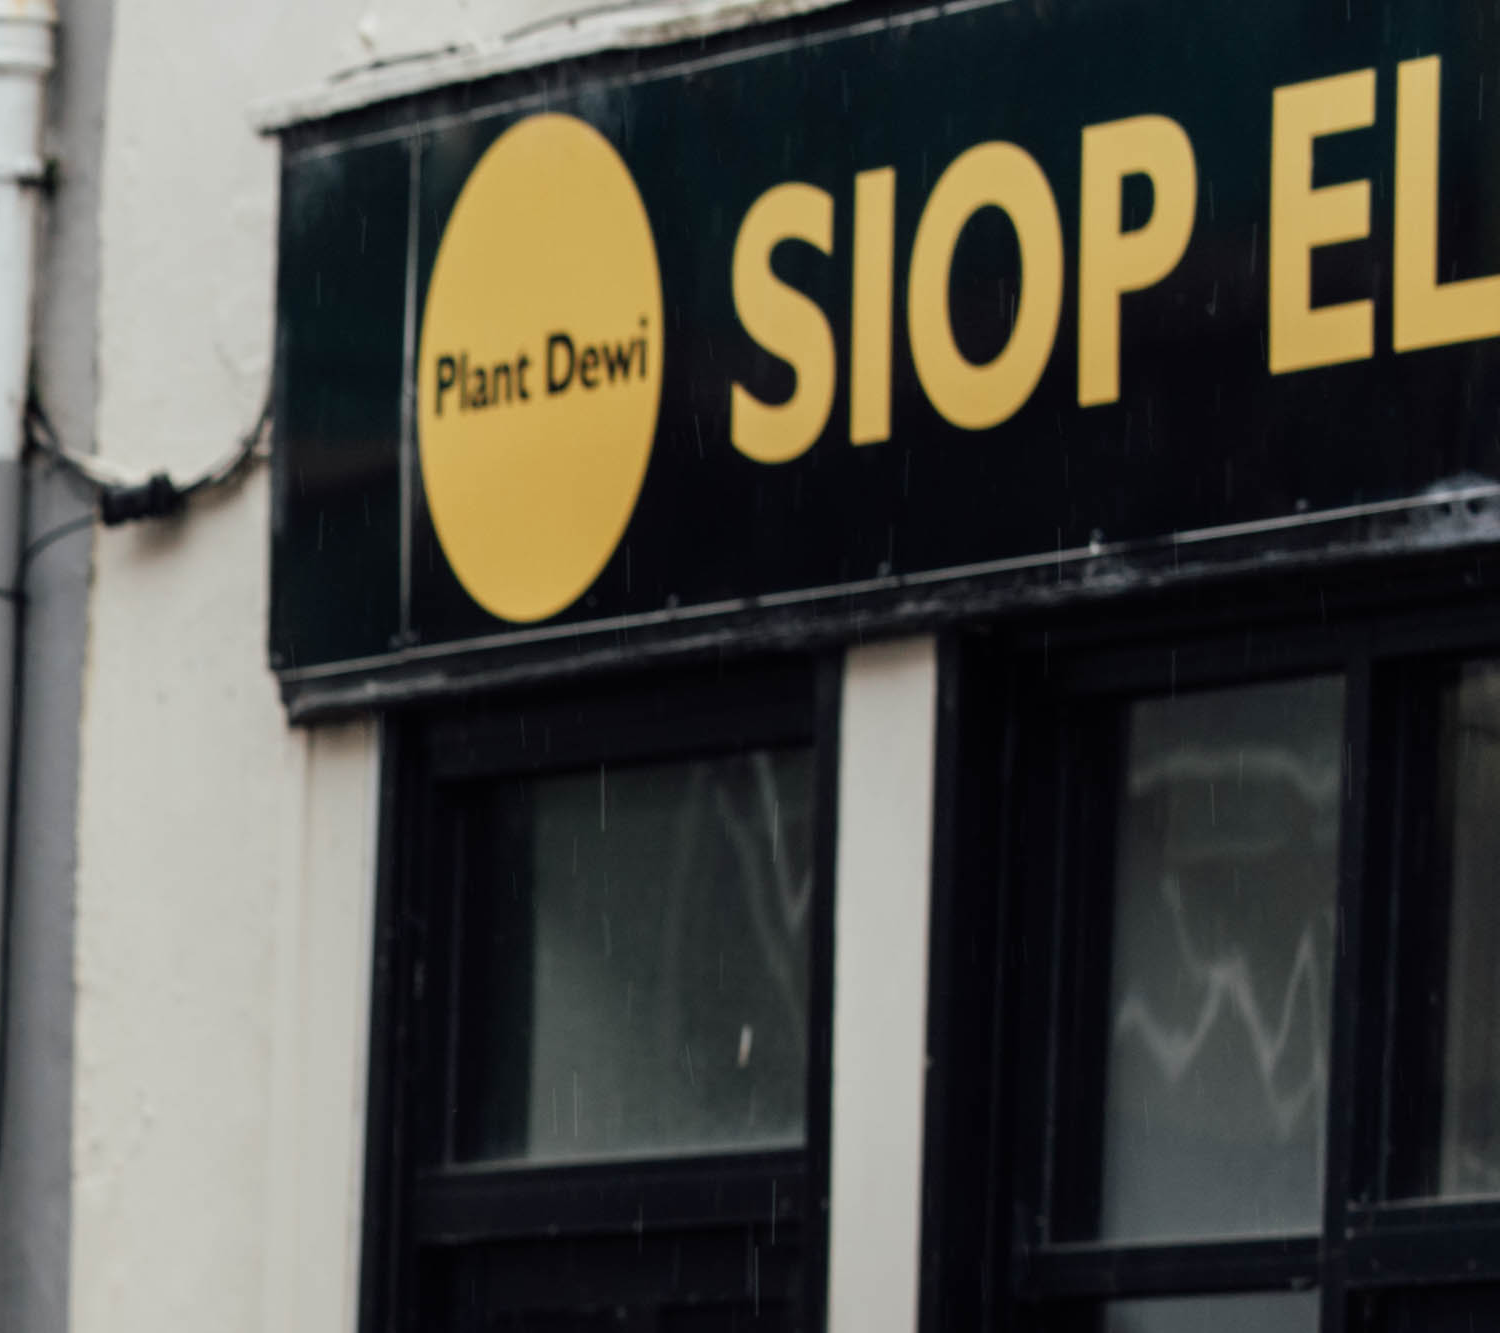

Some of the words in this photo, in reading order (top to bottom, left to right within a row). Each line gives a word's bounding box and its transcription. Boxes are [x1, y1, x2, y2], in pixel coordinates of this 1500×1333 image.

[434, 350, 530, 418] Plant
[546, 315, 650, 397] Dewi
[730, 114, 1198, 465] SIOP
[1269, 55, 1500, 375] EL
